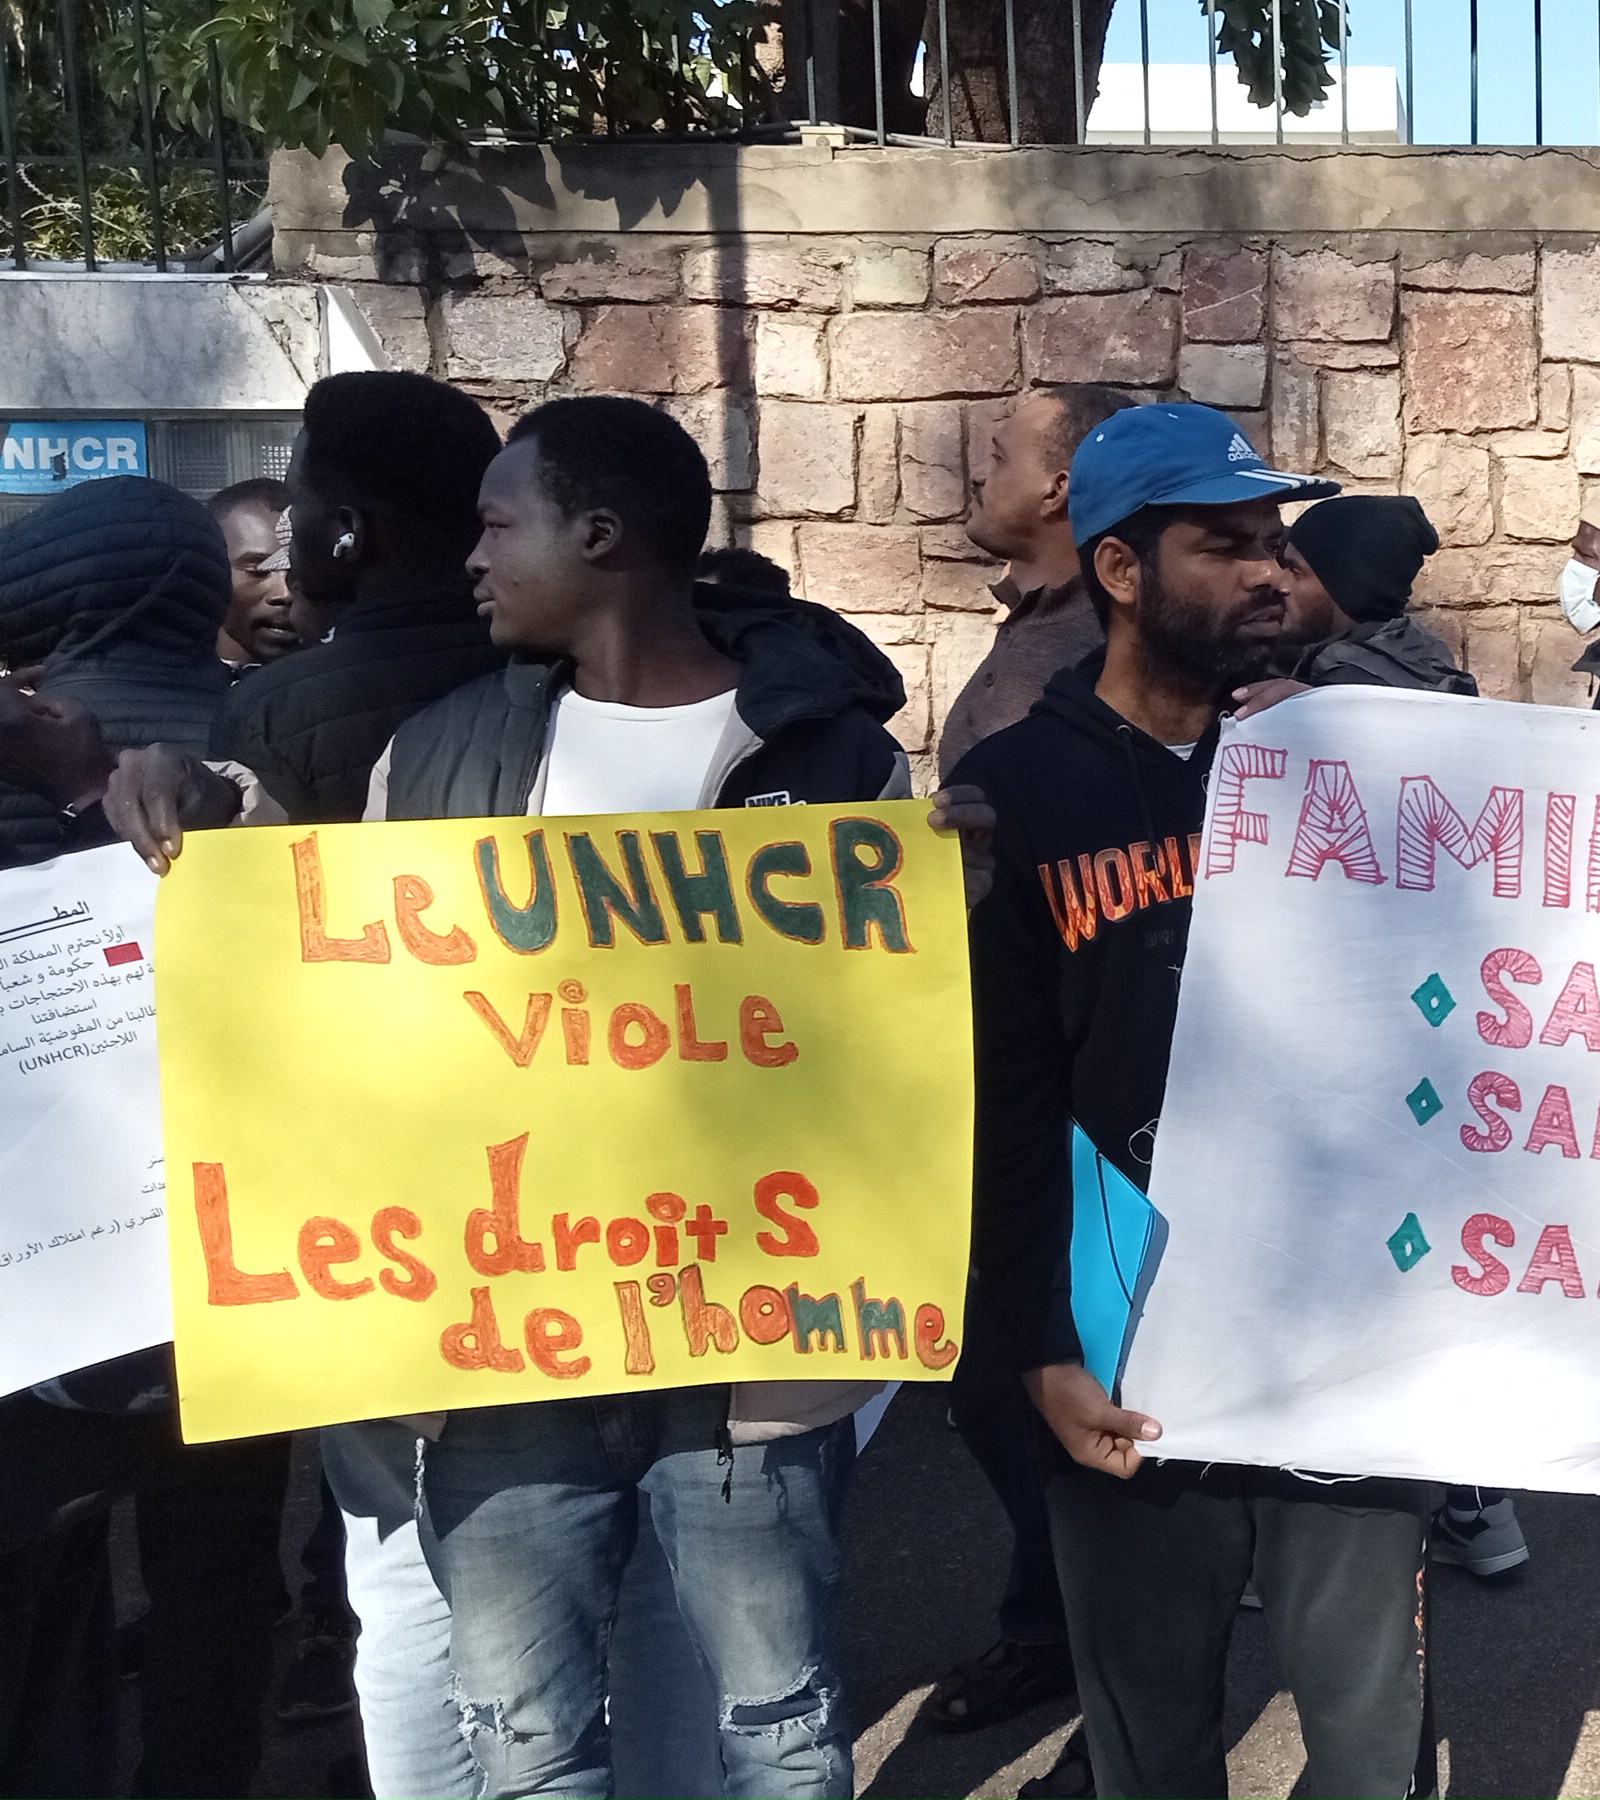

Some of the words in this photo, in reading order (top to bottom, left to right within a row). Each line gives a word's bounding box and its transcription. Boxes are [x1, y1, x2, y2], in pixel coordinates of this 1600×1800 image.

[2, 436, 139, 470] NHCR
[289, 829, 479, 964] Le
[473, 816, 919, 956] UNHCR
[13, 944, 62, 965] المملكة
[48, 957, 95, 978] حكومة
[106, 1017, 124, 1031] من
[192, 1161, 438, 1306] Les
[439, 1286, 592, 1380] de
